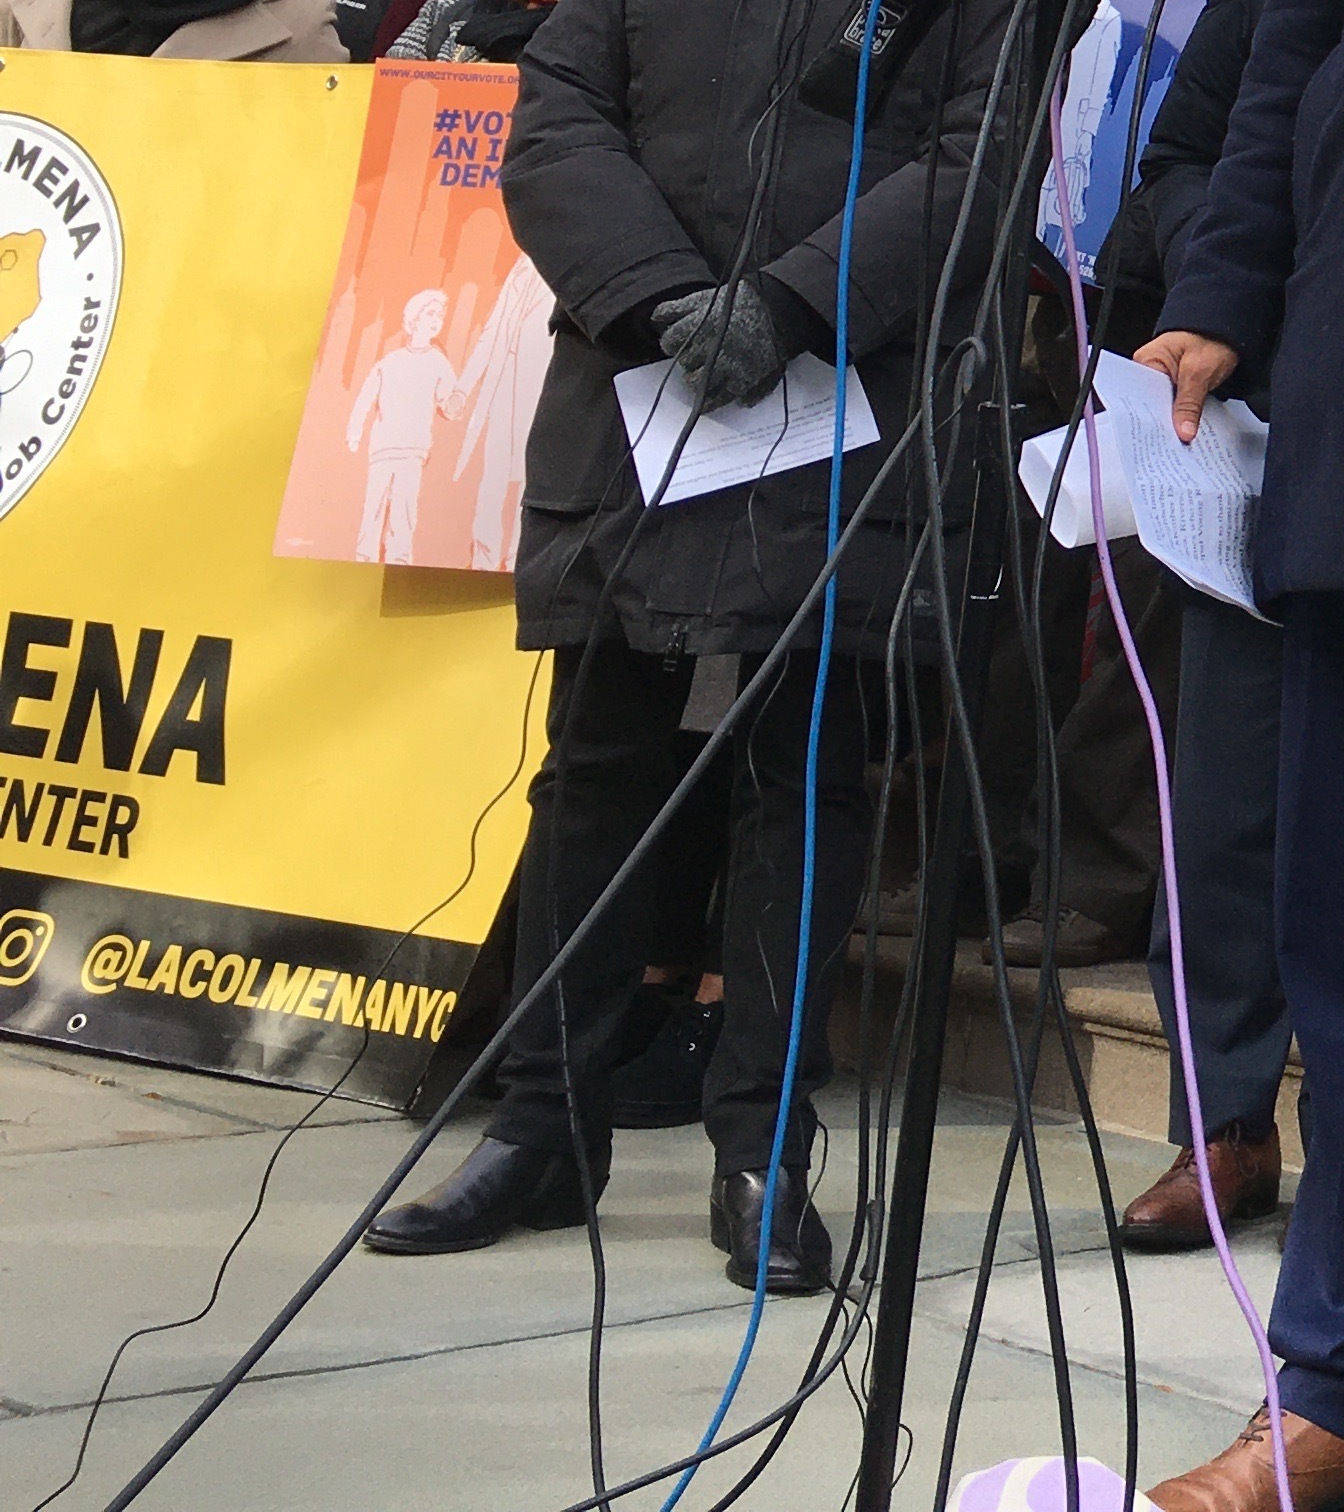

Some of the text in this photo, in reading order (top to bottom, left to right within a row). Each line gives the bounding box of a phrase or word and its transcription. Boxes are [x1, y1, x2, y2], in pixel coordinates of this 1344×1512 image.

[379, 67, 520, 85] WWW.OURCITYOURVOTE.OR
[432, 136, 477, 162] AN
[439, 163, 503, 189] DEM
[4, 138, 102, 261] MENA
[41, 295, 102, 426] Center
[0, 775, 141, 860] NTER
